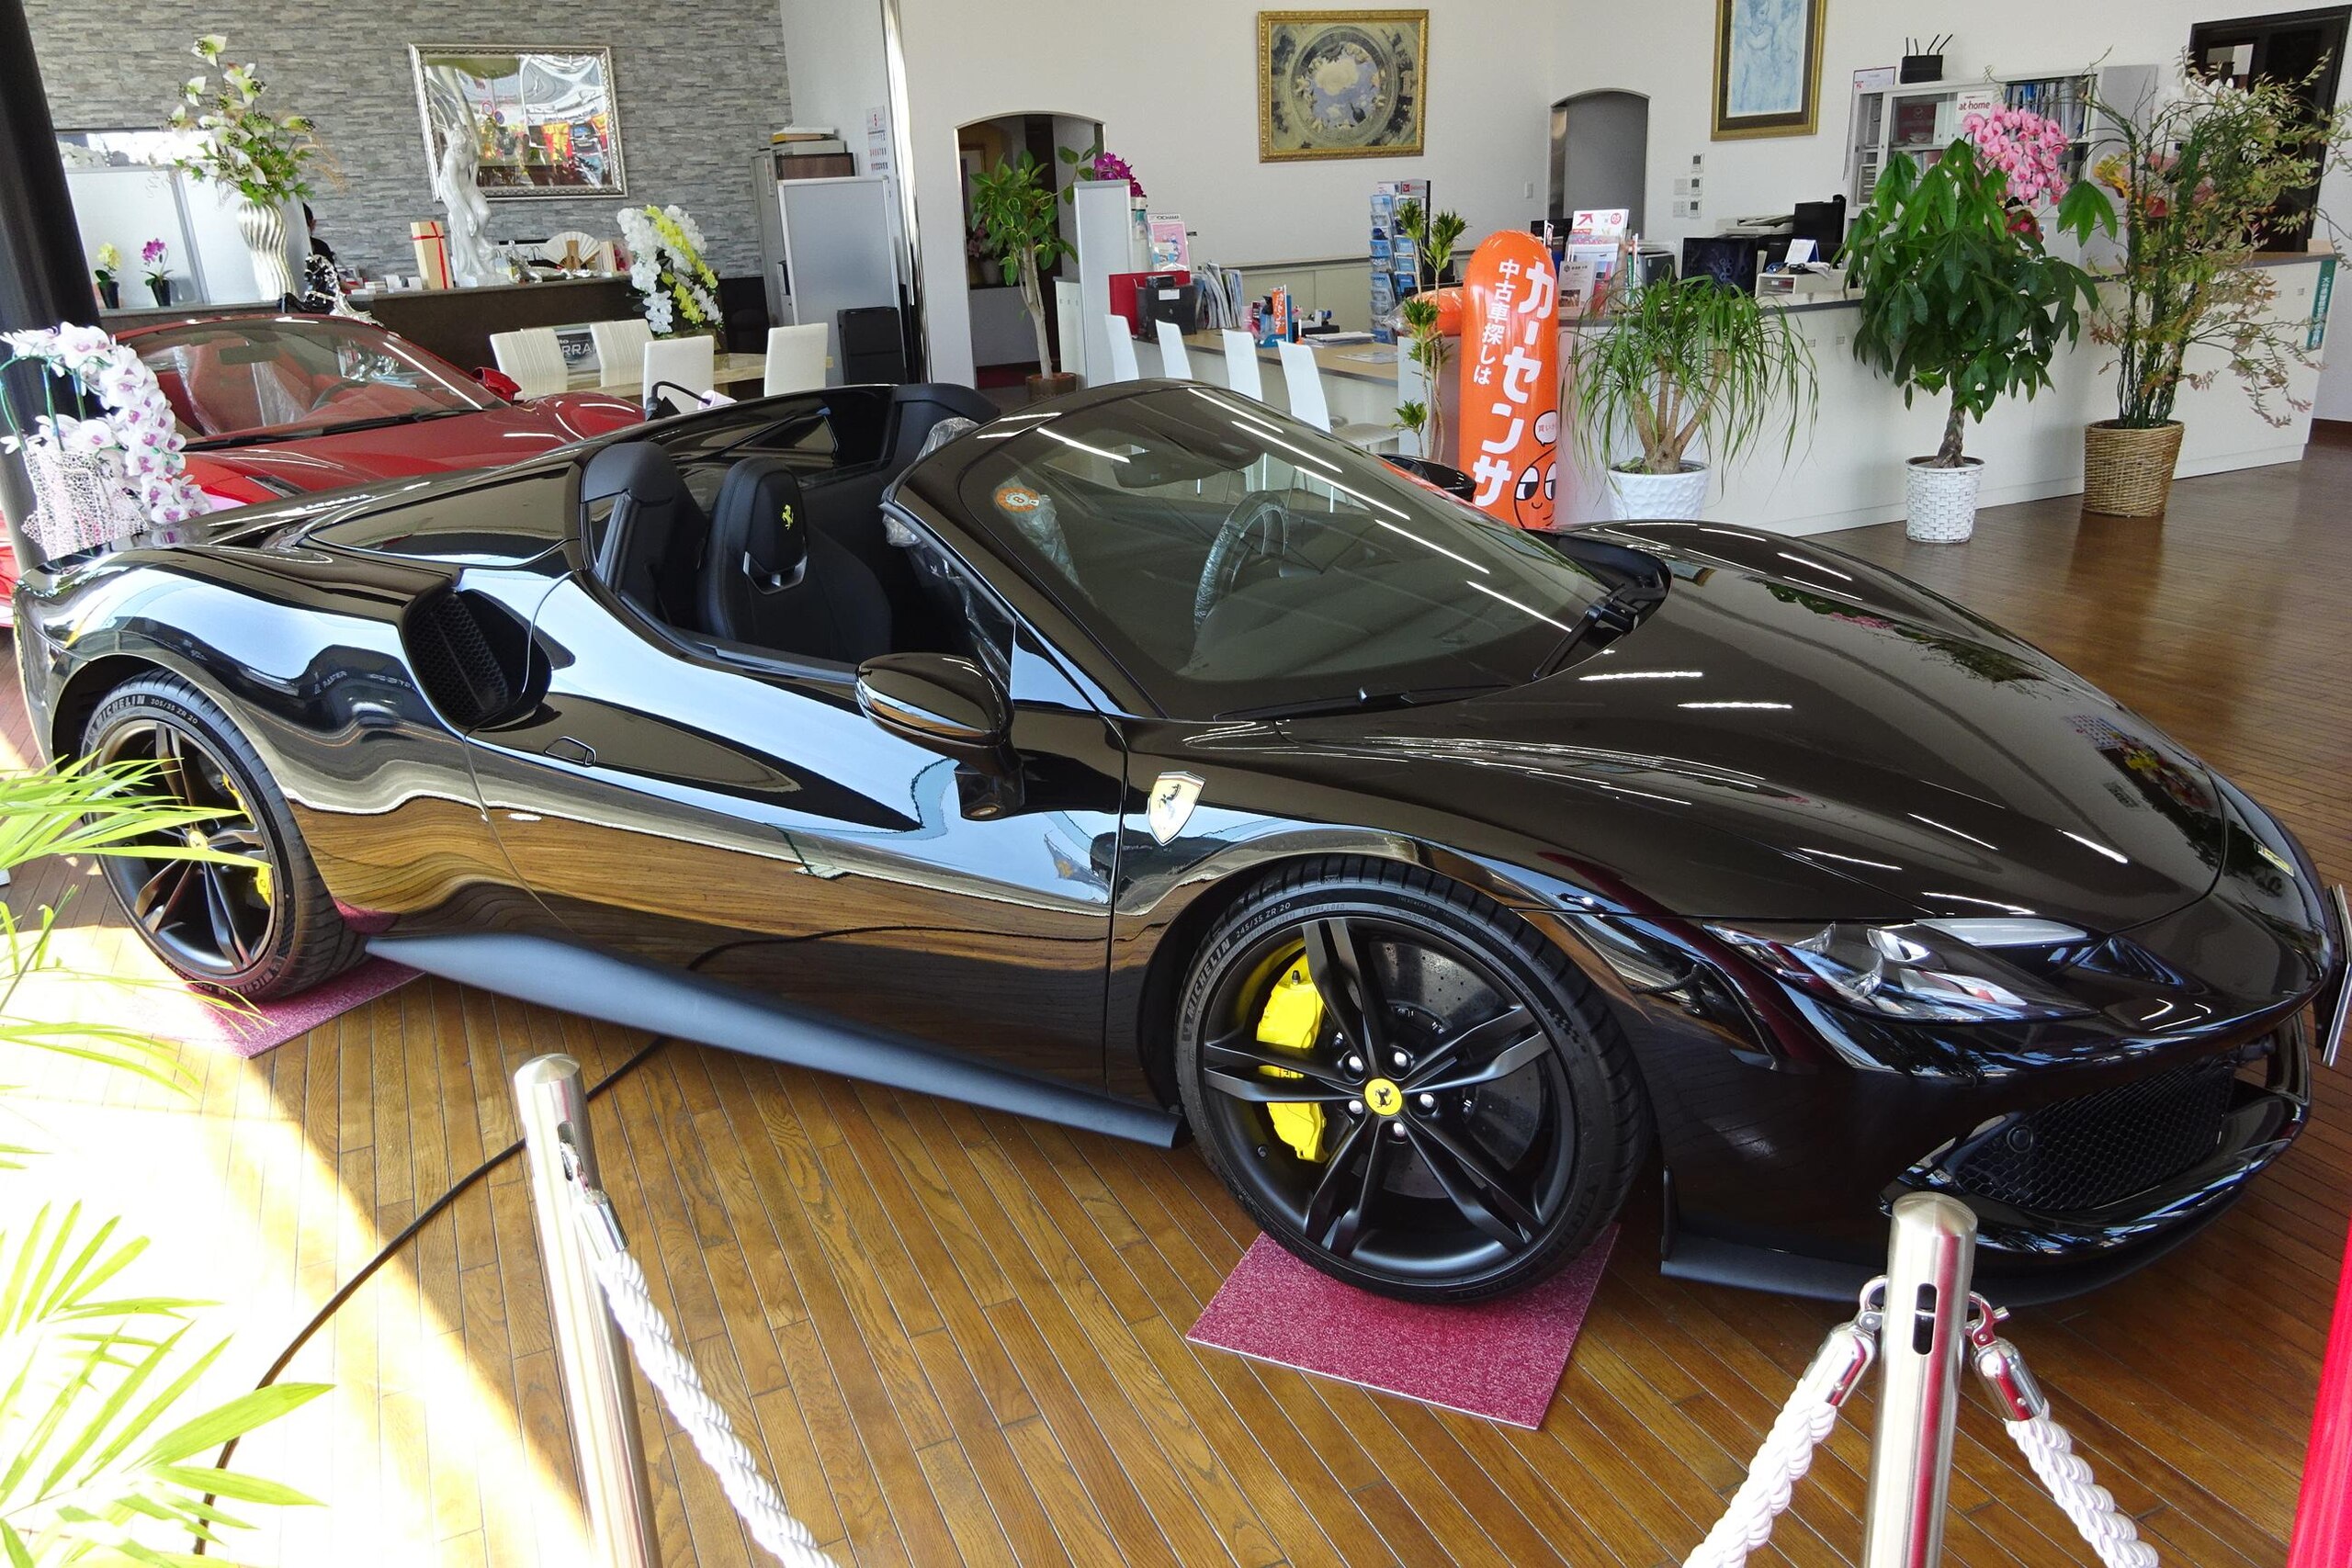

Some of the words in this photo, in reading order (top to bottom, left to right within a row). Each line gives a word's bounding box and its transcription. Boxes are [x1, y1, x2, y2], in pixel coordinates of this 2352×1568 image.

[1968, 100, 1991, 110] home
[1473, 258, 1521, 385] 中古車探しは
[1473, 261, 1555, 507] カーセンサ
[96, 694, 146, 728] MICHELIN
[187, 714, 198, 724] 20
[1188, 937, 1231, 1020] MICHELIN
[1236, 915, 1263, 938] 245/35
[1265, 907, 1278, 919] ZR
[1279, 901, 1292, 912] 20
